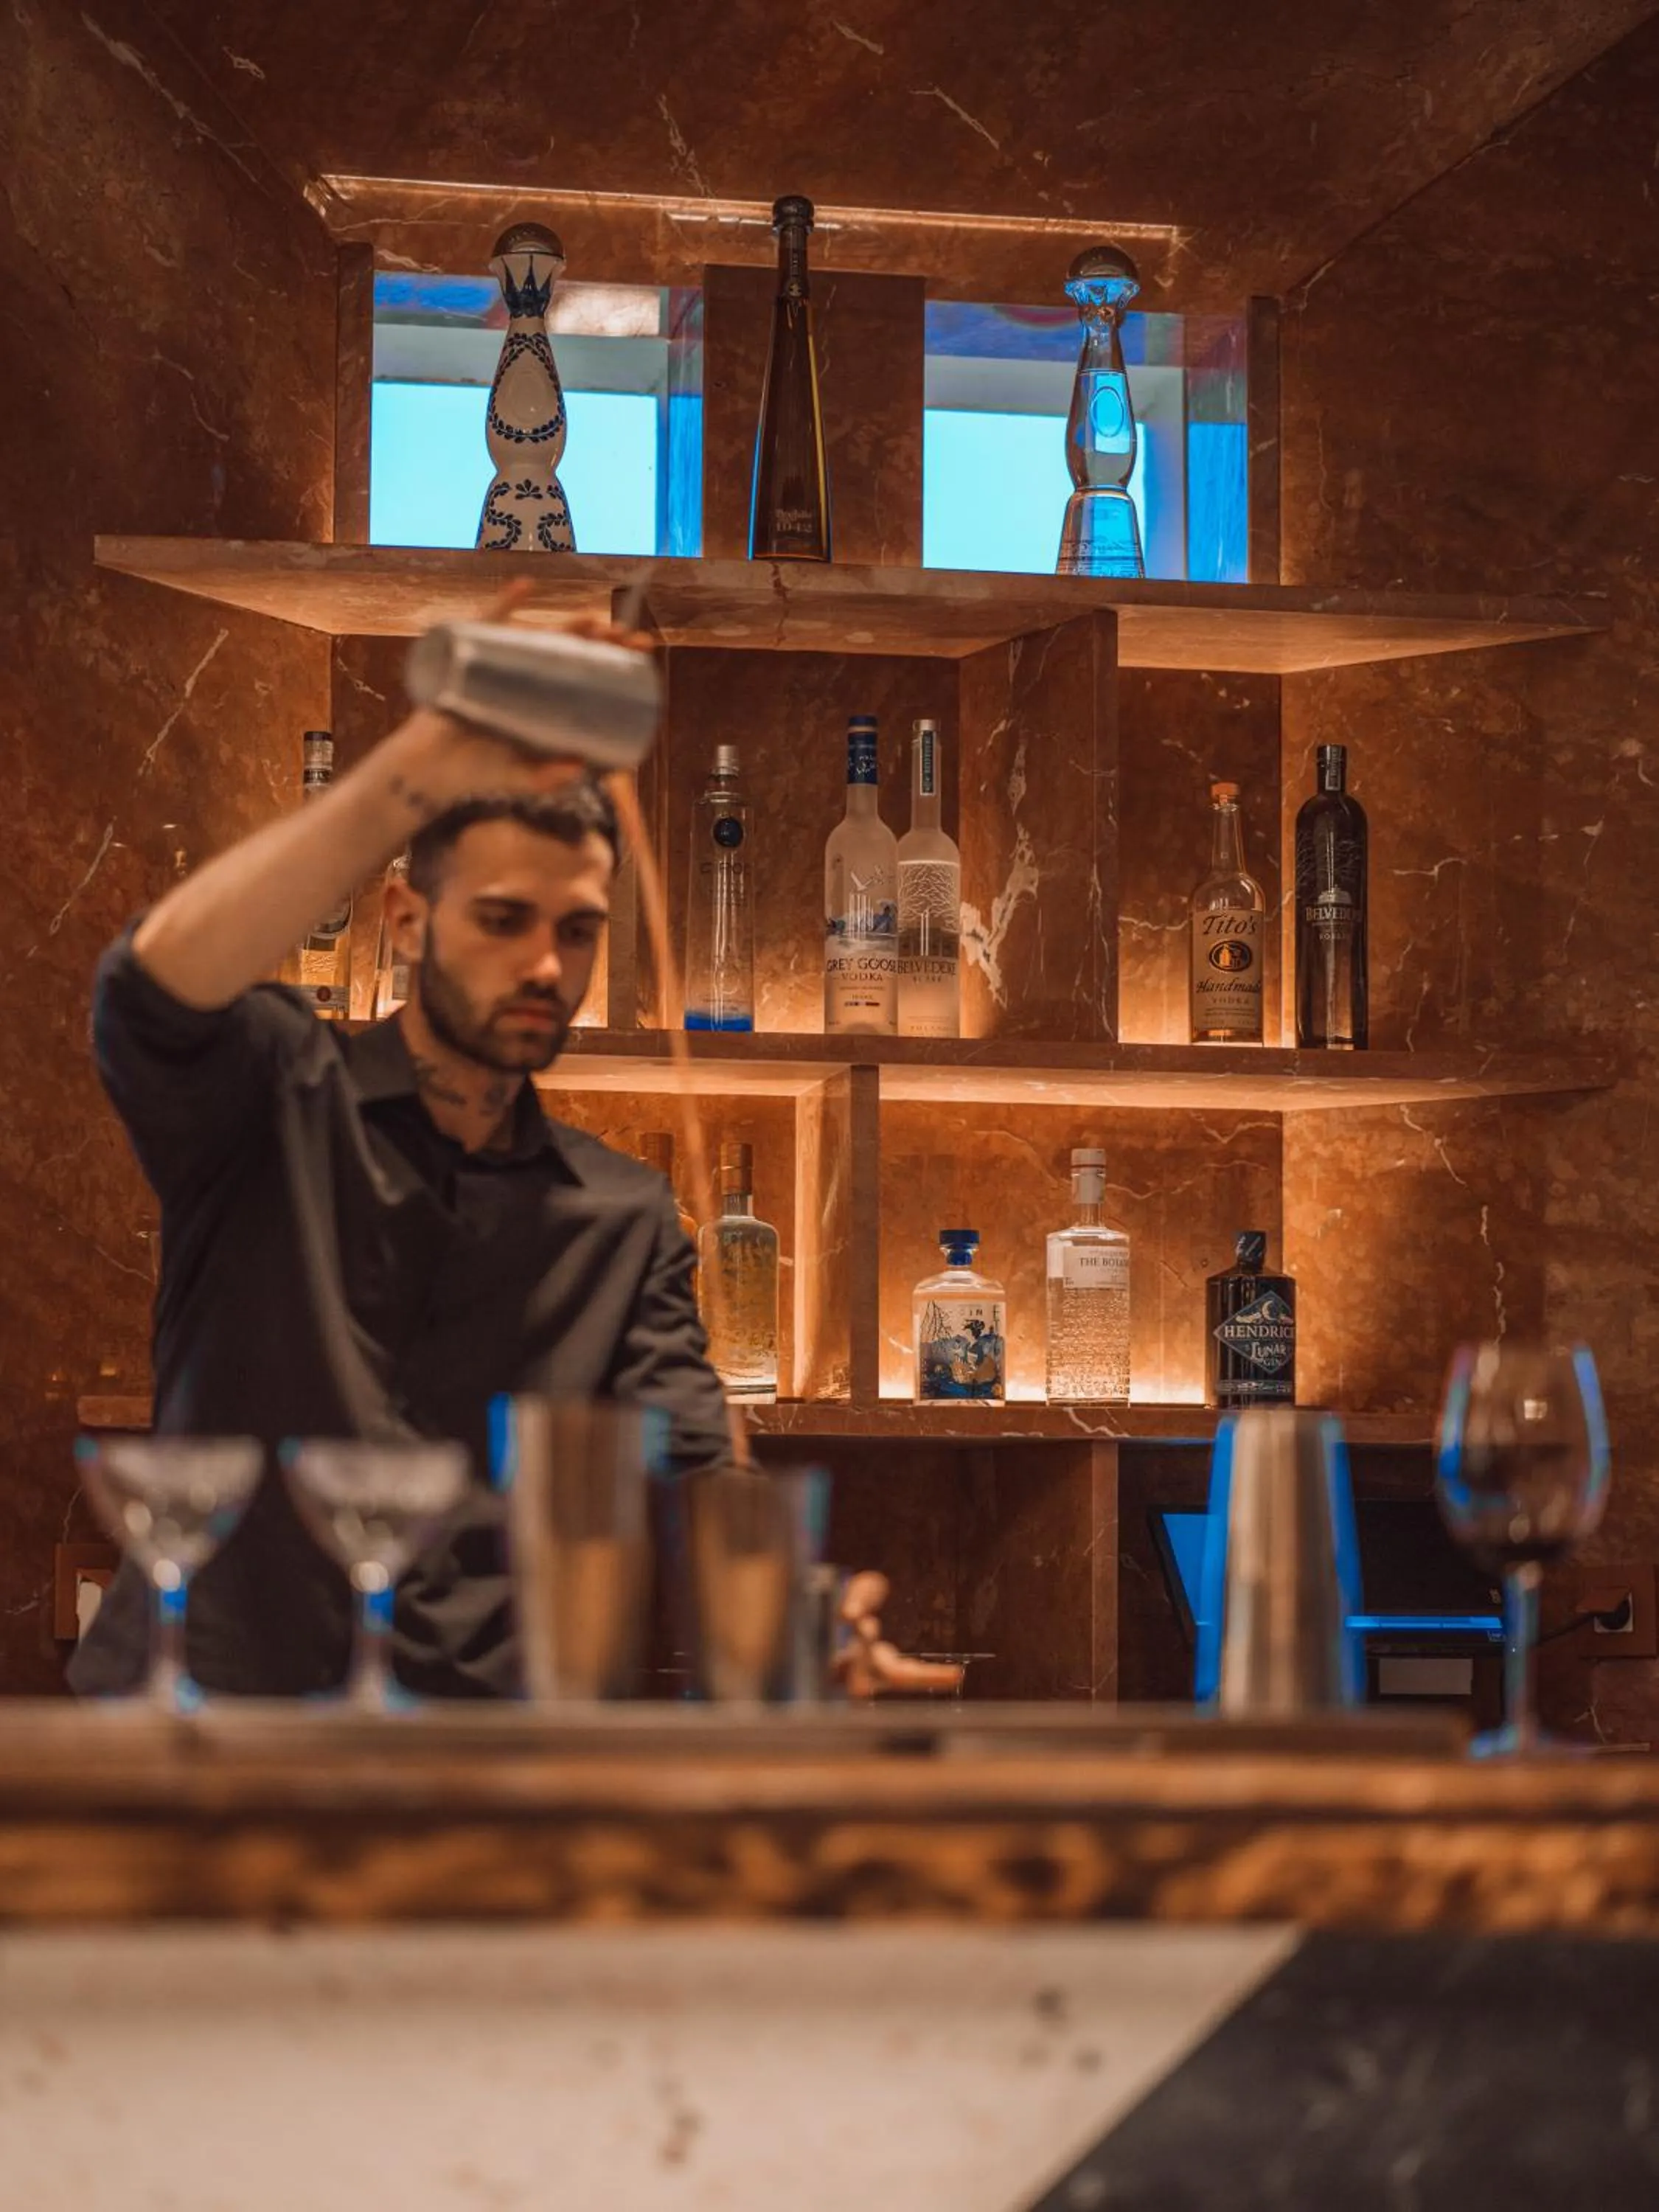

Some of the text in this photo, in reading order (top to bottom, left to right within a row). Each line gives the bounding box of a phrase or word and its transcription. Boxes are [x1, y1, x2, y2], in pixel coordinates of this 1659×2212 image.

[1203, 914, 1256, 935] Tito's
[827, 958, 854, 972] GREY
[841, 973, 883, 981] VODKA
[1079, 1257, 1098, 1267] THE
